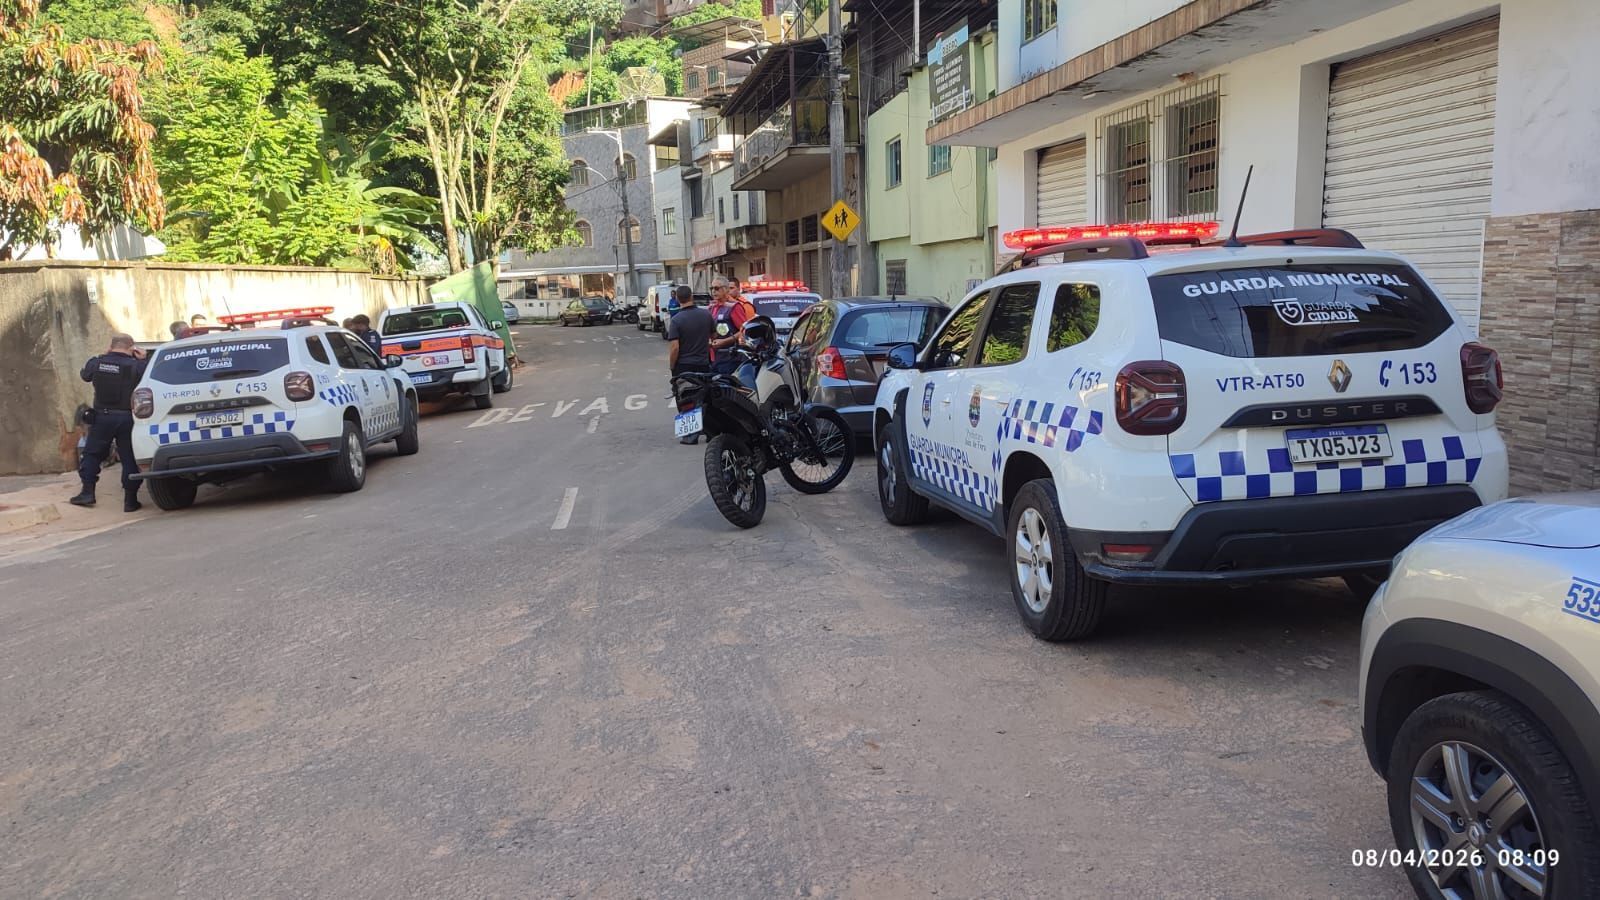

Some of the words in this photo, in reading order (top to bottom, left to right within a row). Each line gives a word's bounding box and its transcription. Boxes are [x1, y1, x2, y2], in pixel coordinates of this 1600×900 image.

[1182, 276, 1285, 298] GUARDA
[1287, 272, 1410, 287] MUNICIPAL
[1303, 301, 1354, 311] GUARDA
[164, 348, 208, 361] GUARDA
[210, 343, 272, 354] MUNICIPAL
[1080, 371, 1102, 391] 153
[1399, 361, 1437, 385] 153
[246, 382, 268, 393] 153
[1216, 373, 1305, 392] VTR-AT50
[163, 389, 201, 399] VTR-RP30
[185, 399, 250, 411] DUSTER
[1271, 402, 1408, 420] DUSTER
[910, 433, 934, 454] GUARDA
[934, 441, 973, 469] MUNICIPAL
[1297, 435, 1381, 459] TXQ5J23
